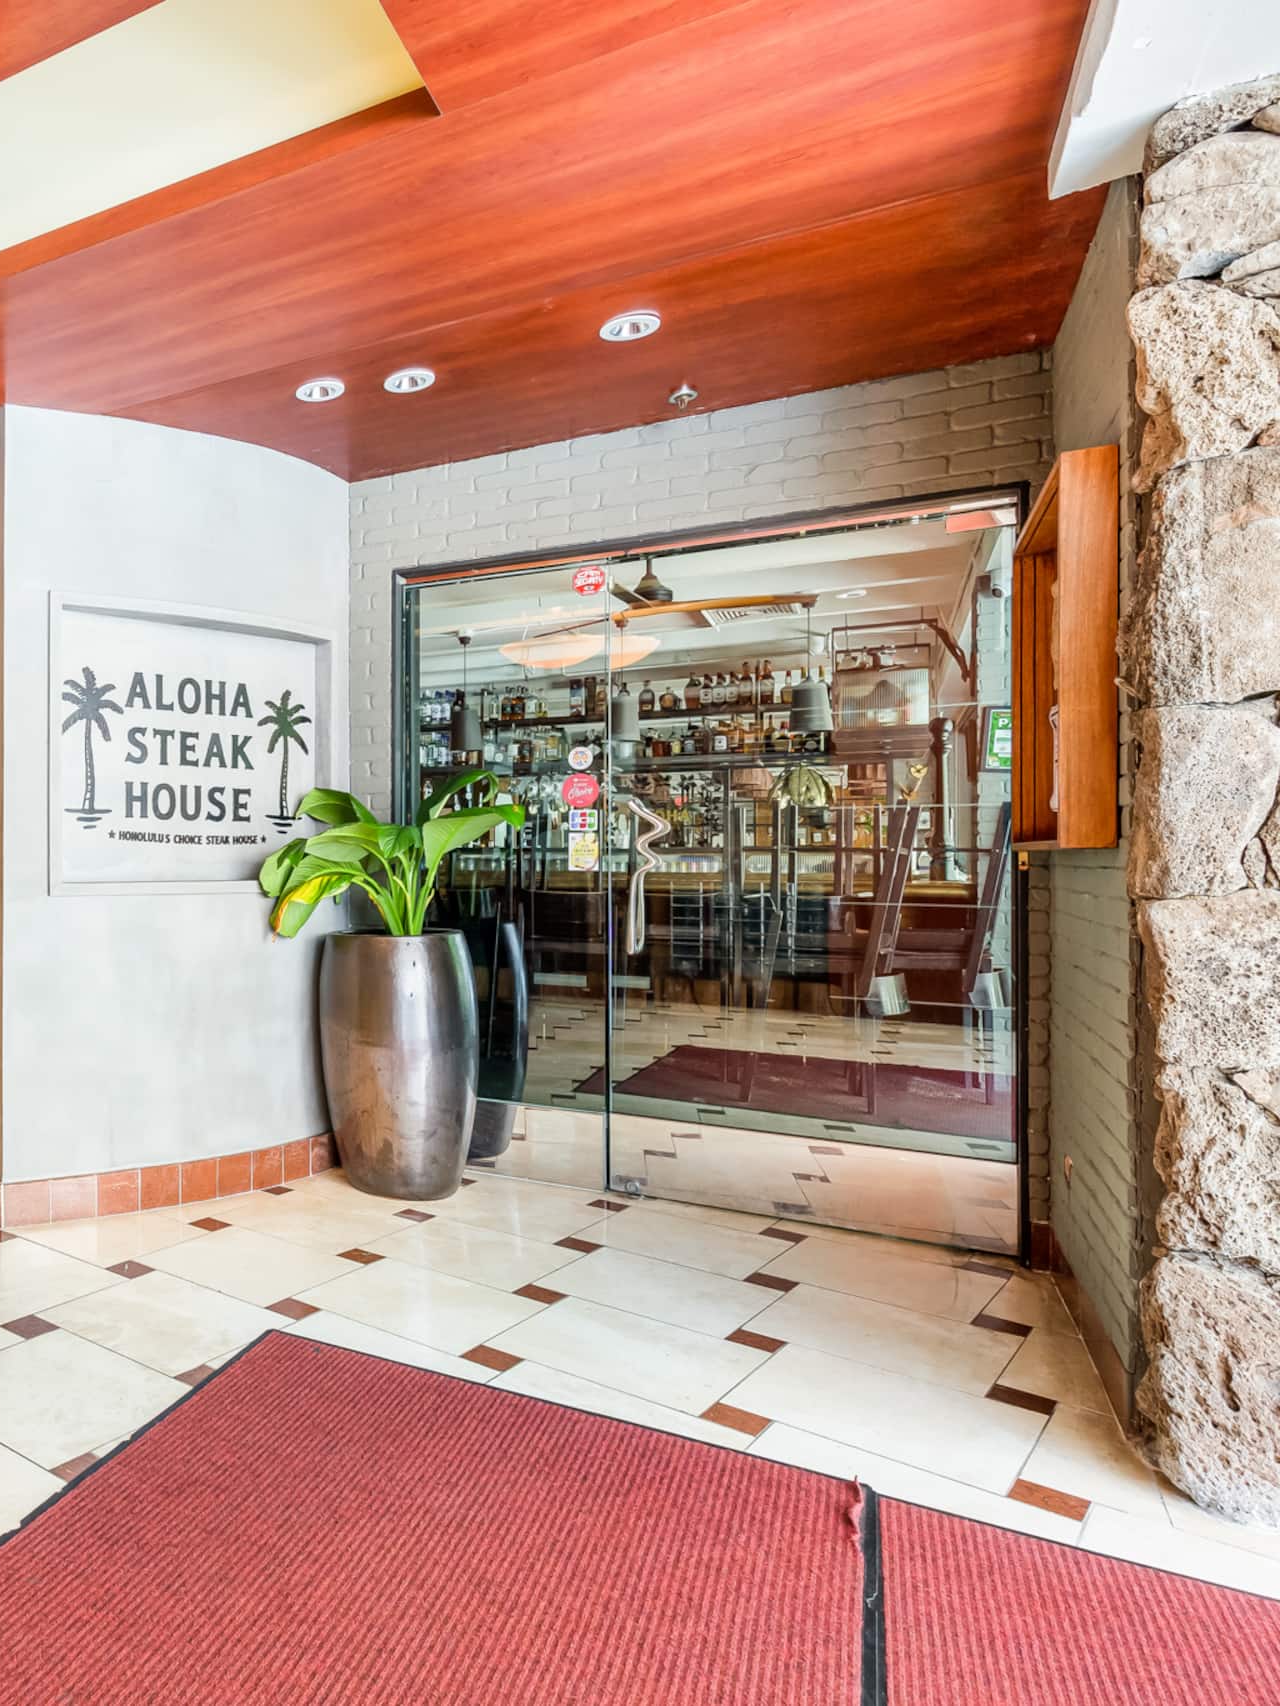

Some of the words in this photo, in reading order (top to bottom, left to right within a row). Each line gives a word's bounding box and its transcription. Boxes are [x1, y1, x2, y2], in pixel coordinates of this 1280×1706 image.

[124, 671, 254, 718] ALOHA
[124, 726, 255, 770] STEAK
[124, 781, 252, 823] HOUSE
[173, 834, 203, 845] CHOICE
[206, 835, 231, 845] STEAK
[232, 834, 259, 845] HOUSE
